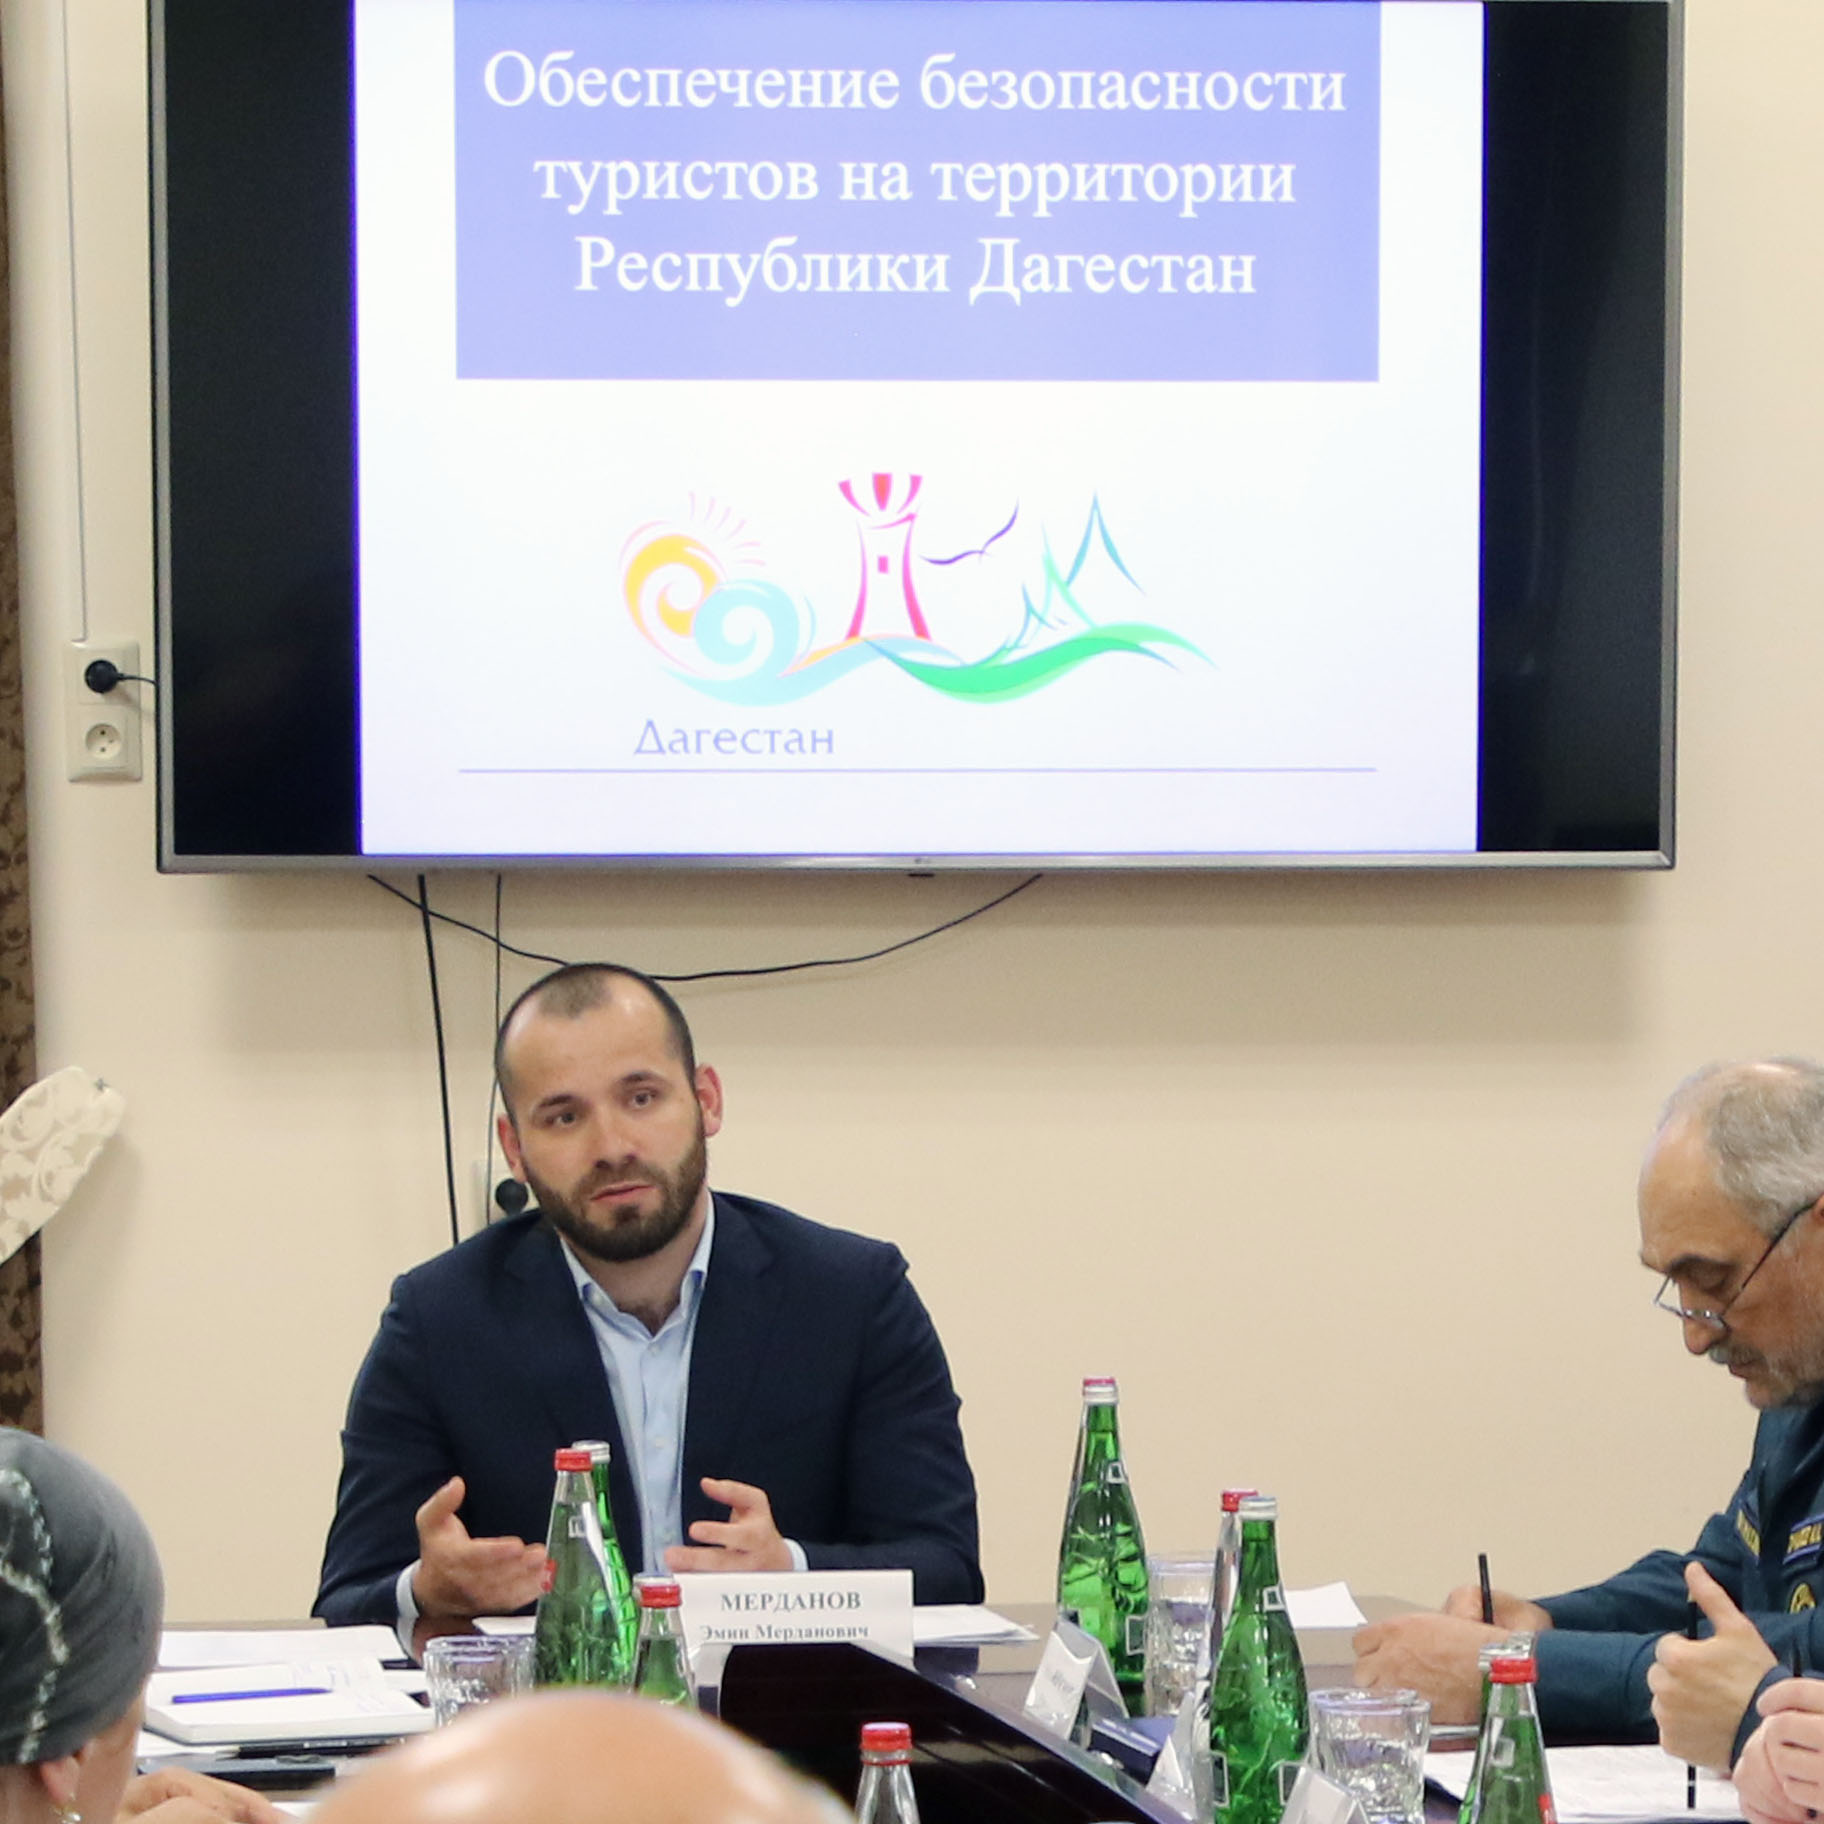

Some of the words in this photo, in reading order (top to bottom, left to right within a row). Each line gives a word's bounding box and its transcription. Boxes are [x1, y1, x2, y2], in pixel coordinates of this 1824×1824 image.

[483, 50, 900, 109] Обеспечение
[920, 52, 1346, 111] безопасности
[532, 160, 819, 215] туристов
[839, 161, 913, 200] на
[930, 161, 1296, 218] территории
[574, 235, 951, 308] Республики
[969, 237, 1256, 307] Дагестан
[632, 718, 835, 756] Дагестан
[721, 1591, 862, 1613] МЕРДАНОВ
[755, 1624, 869, 1642] Мерданович
